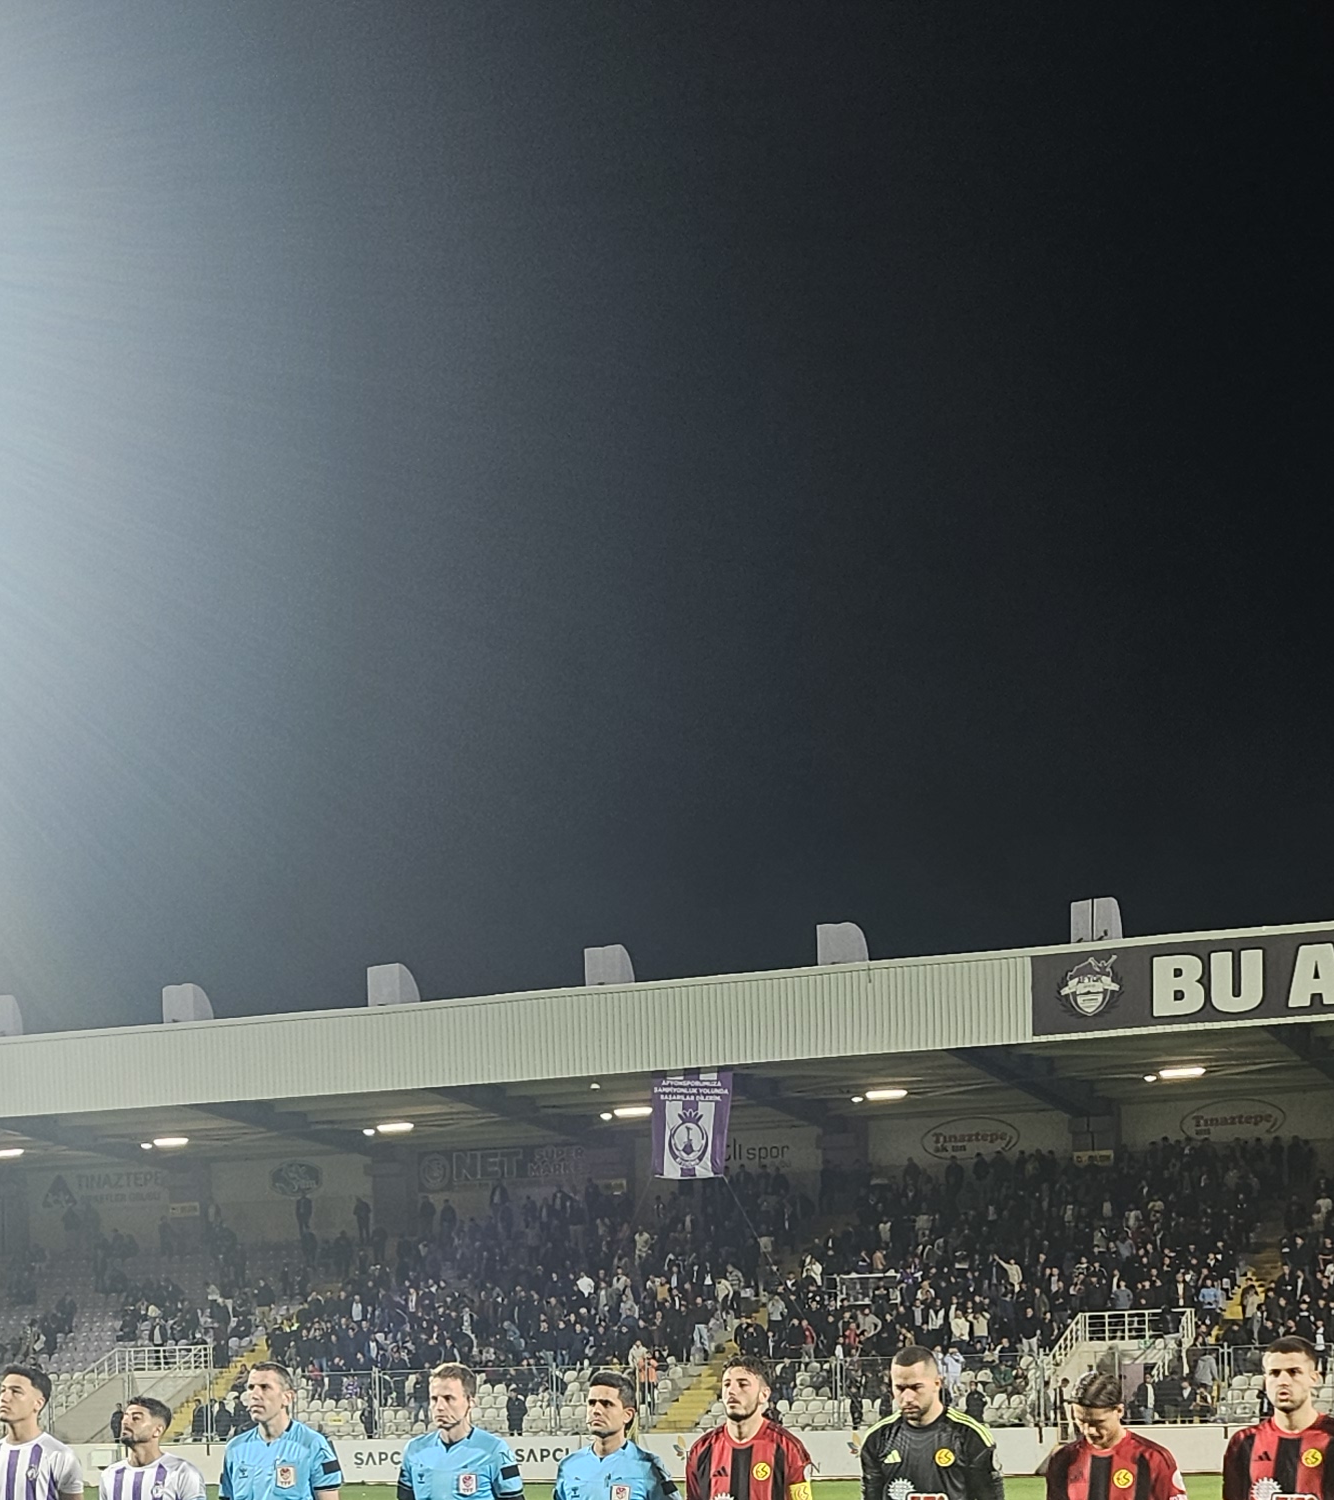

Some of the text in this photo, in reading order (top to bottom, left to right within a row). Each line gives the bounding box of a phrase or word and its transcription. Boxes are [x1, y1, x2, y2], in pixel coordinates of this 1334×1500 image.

[1151, 948, 1264, 1017] BU
[75, 1170, 163, 1191] TINAZTEPE
[452, 1150, 524, 1181] NET
